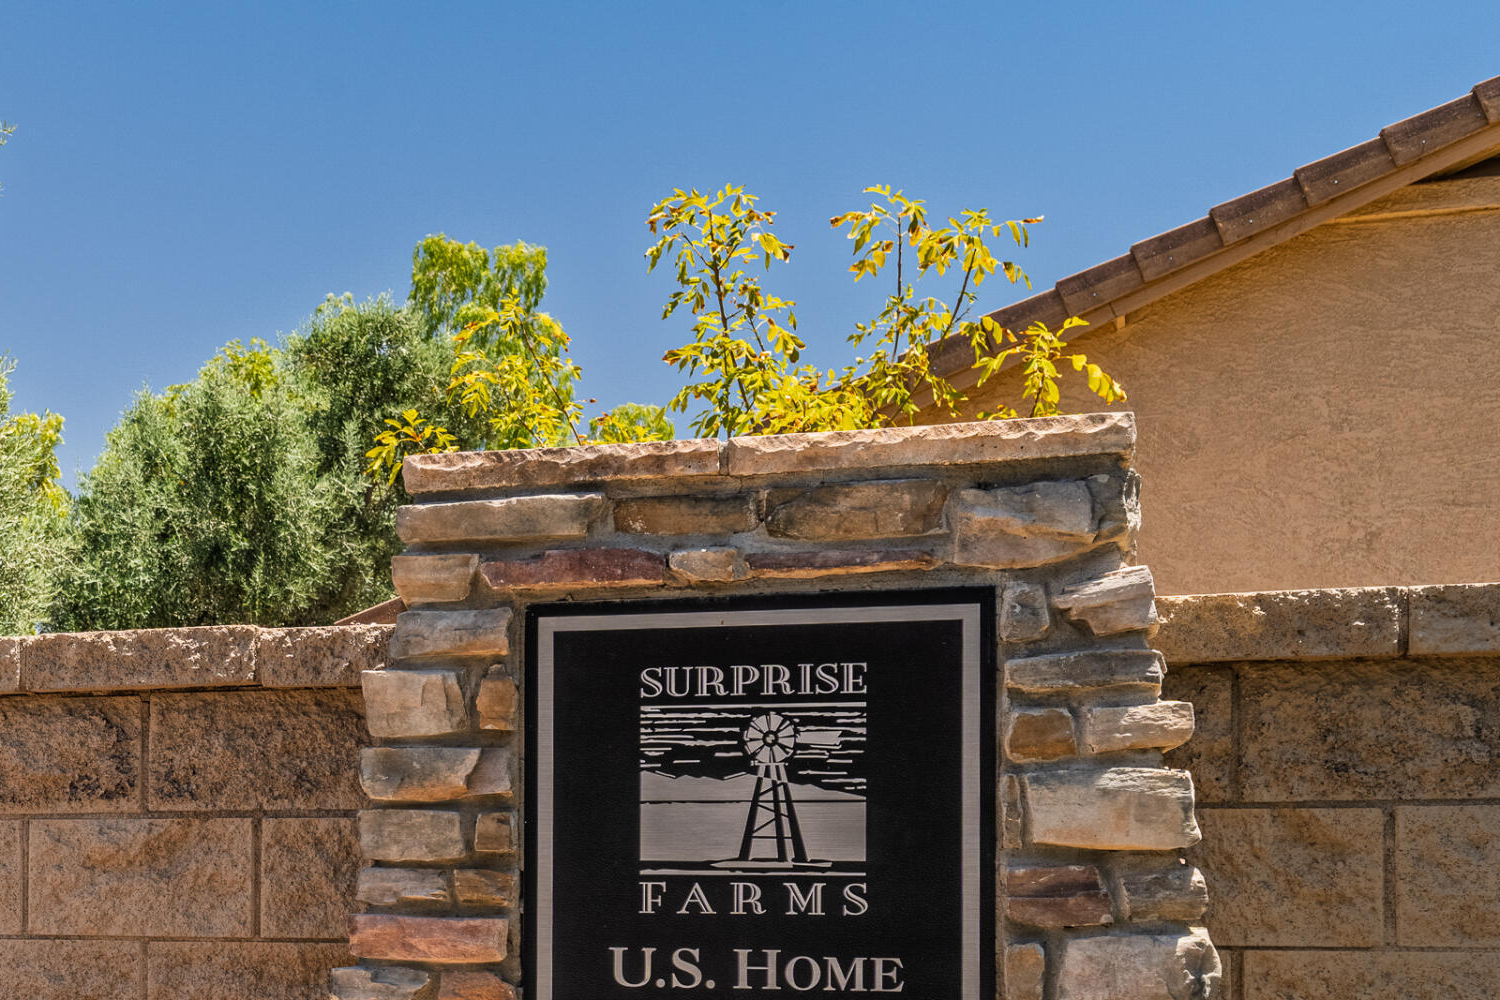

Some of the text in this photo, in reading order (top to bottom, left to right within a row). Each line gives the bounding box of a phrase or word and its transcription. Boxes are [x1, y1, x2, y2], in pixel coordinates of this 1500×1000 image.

[639, 662, 868, 698] SURPRISE
[638, 881, 869, 916] FARMS
[608, 946, 905, 993] U.S. HOME
